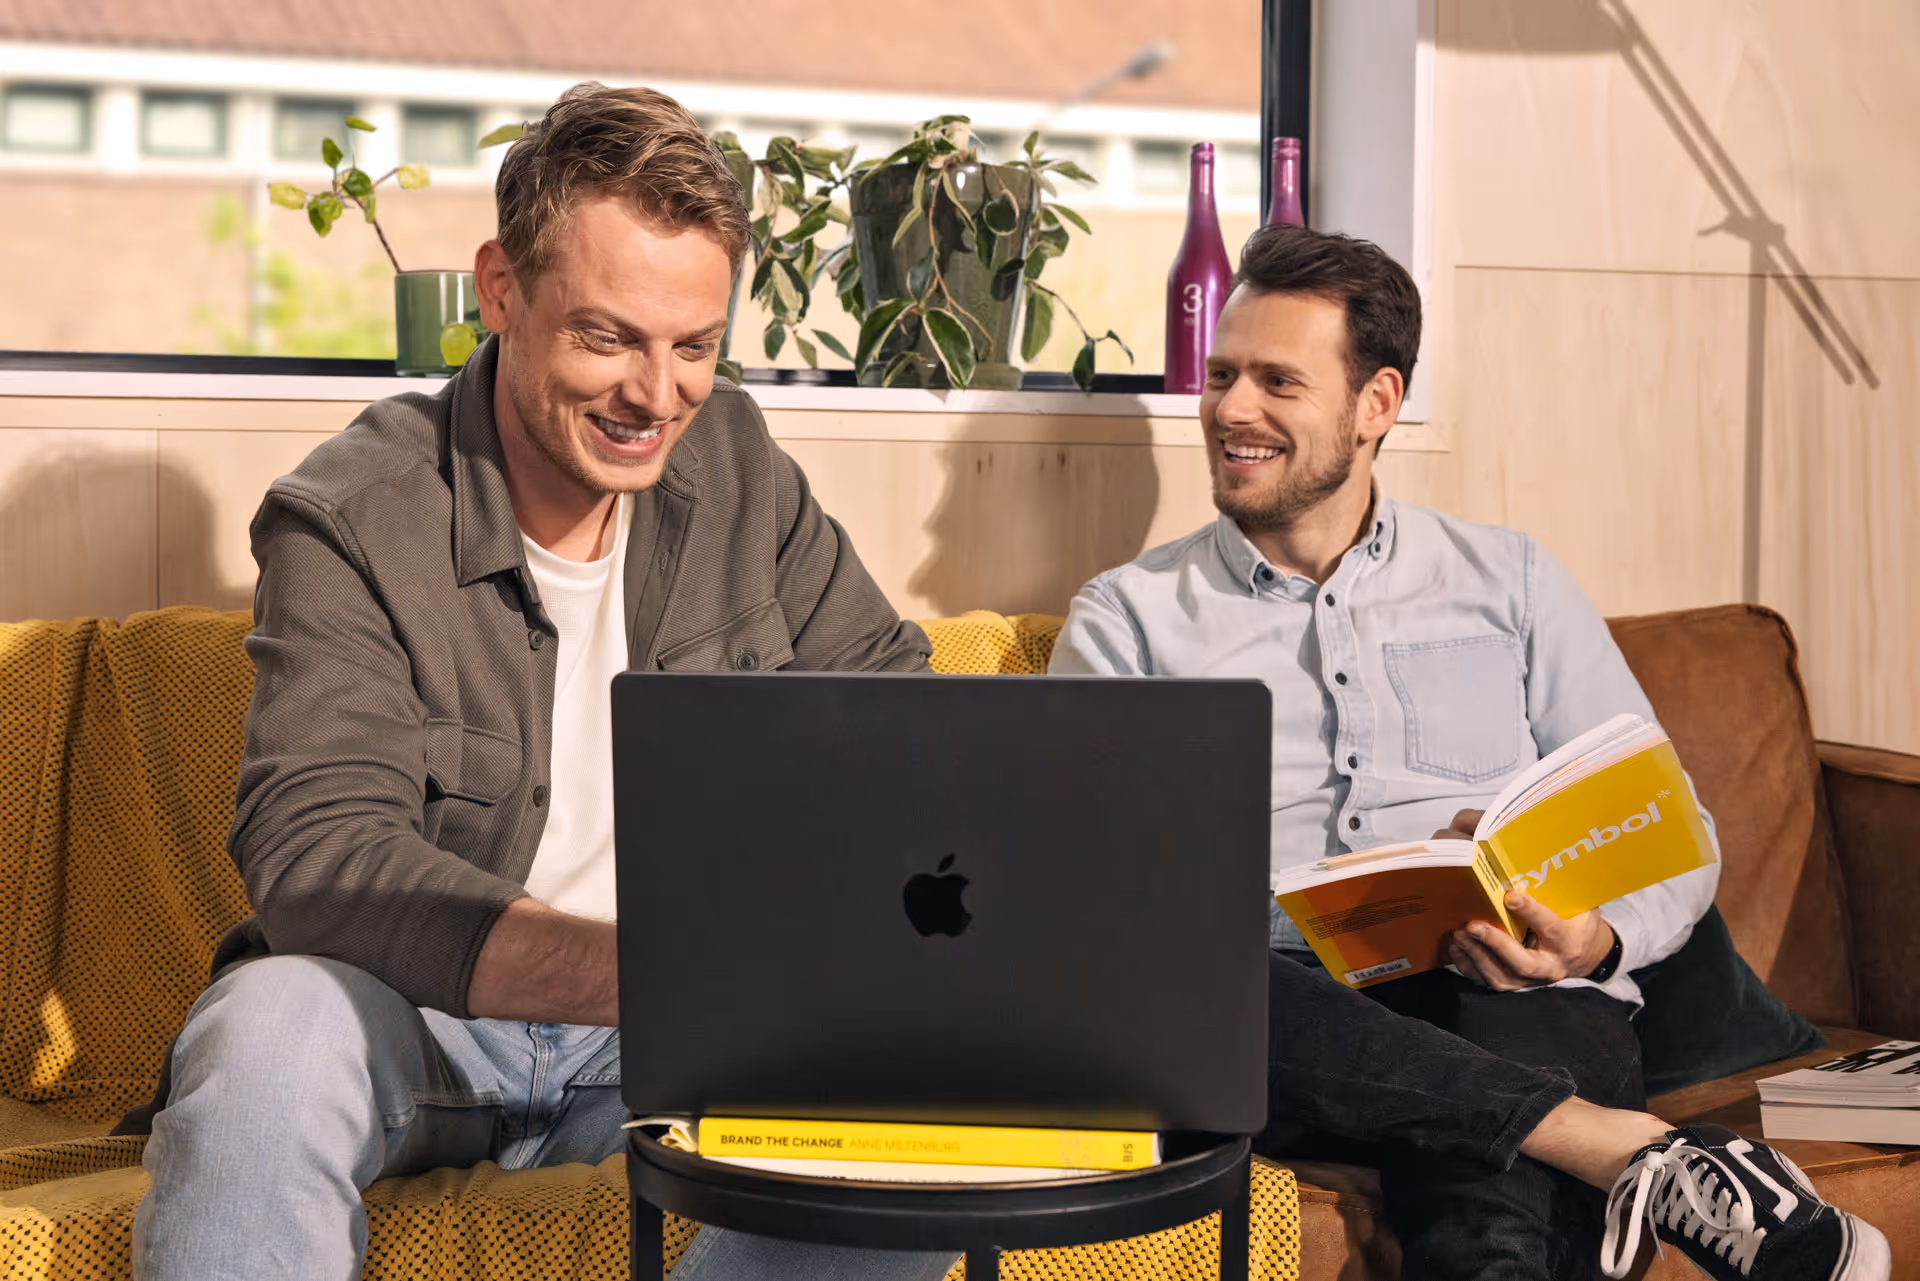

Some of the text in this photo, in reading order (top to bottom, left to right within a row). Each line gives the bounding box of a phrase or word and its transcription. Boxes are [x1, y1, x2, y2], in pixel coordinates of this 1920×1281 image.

[1183, 283, 1203, 313] 3
[720, 1134, 763, 1146] BRAND
[766, 1136, 789, 1147] THE
[792, 1137, 844, 1149] CHANGE
[849, 1138, 881, 1151] ANNE
